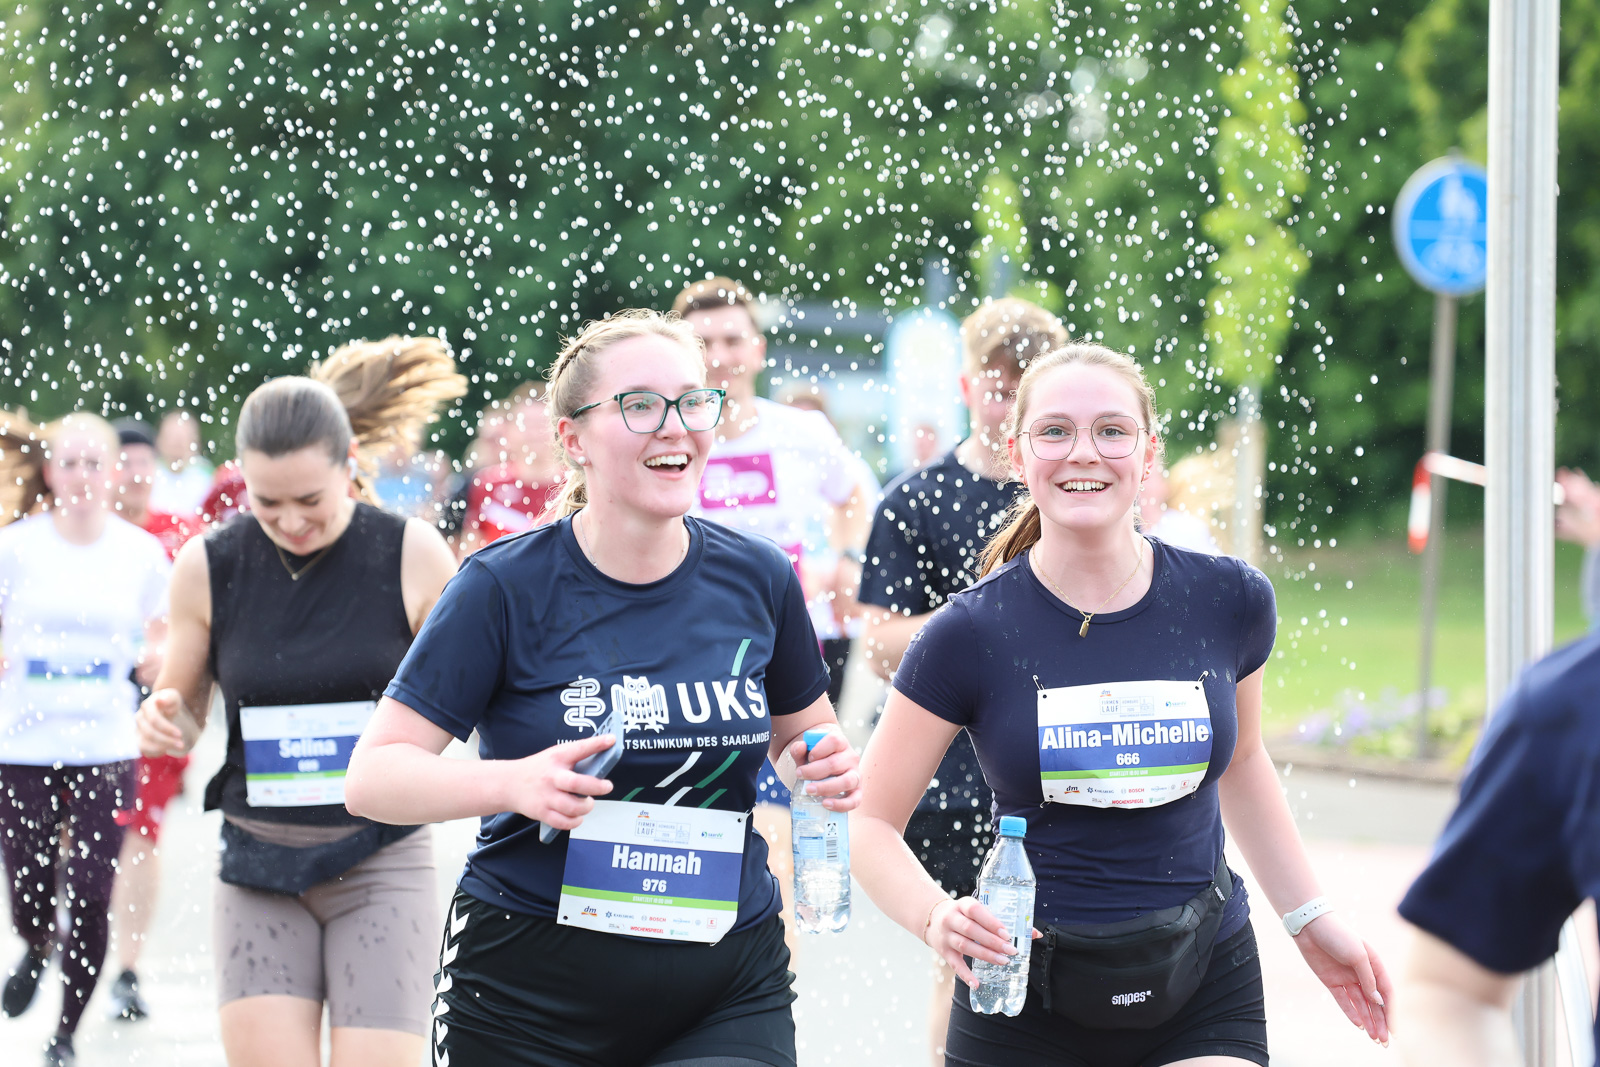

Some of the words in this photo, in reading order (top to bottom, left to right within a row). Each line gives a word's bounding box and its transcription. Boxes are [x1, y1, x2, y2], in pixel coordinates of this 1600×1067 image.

[676, 677, 767, 724] UKS
[1102, 705, 1118, 713] LAUF
[697, 737, 718, 748] DES
[722, 730, 770, 746] SAARLANDES
[1041, 720, 1210, 750] Alina-Michelle
[1116, 752, 1140, 766] 666
[636, 827, 654, 836] LAUF
[611, 844, 702, 875] Hannah
[642, 878, 667, 892] 976
[584, 905, 597, 914] dm
[630, 926, 664, 934] WOCHENSPIEGEL
[1111, 991, 1147, 1006] snipes
